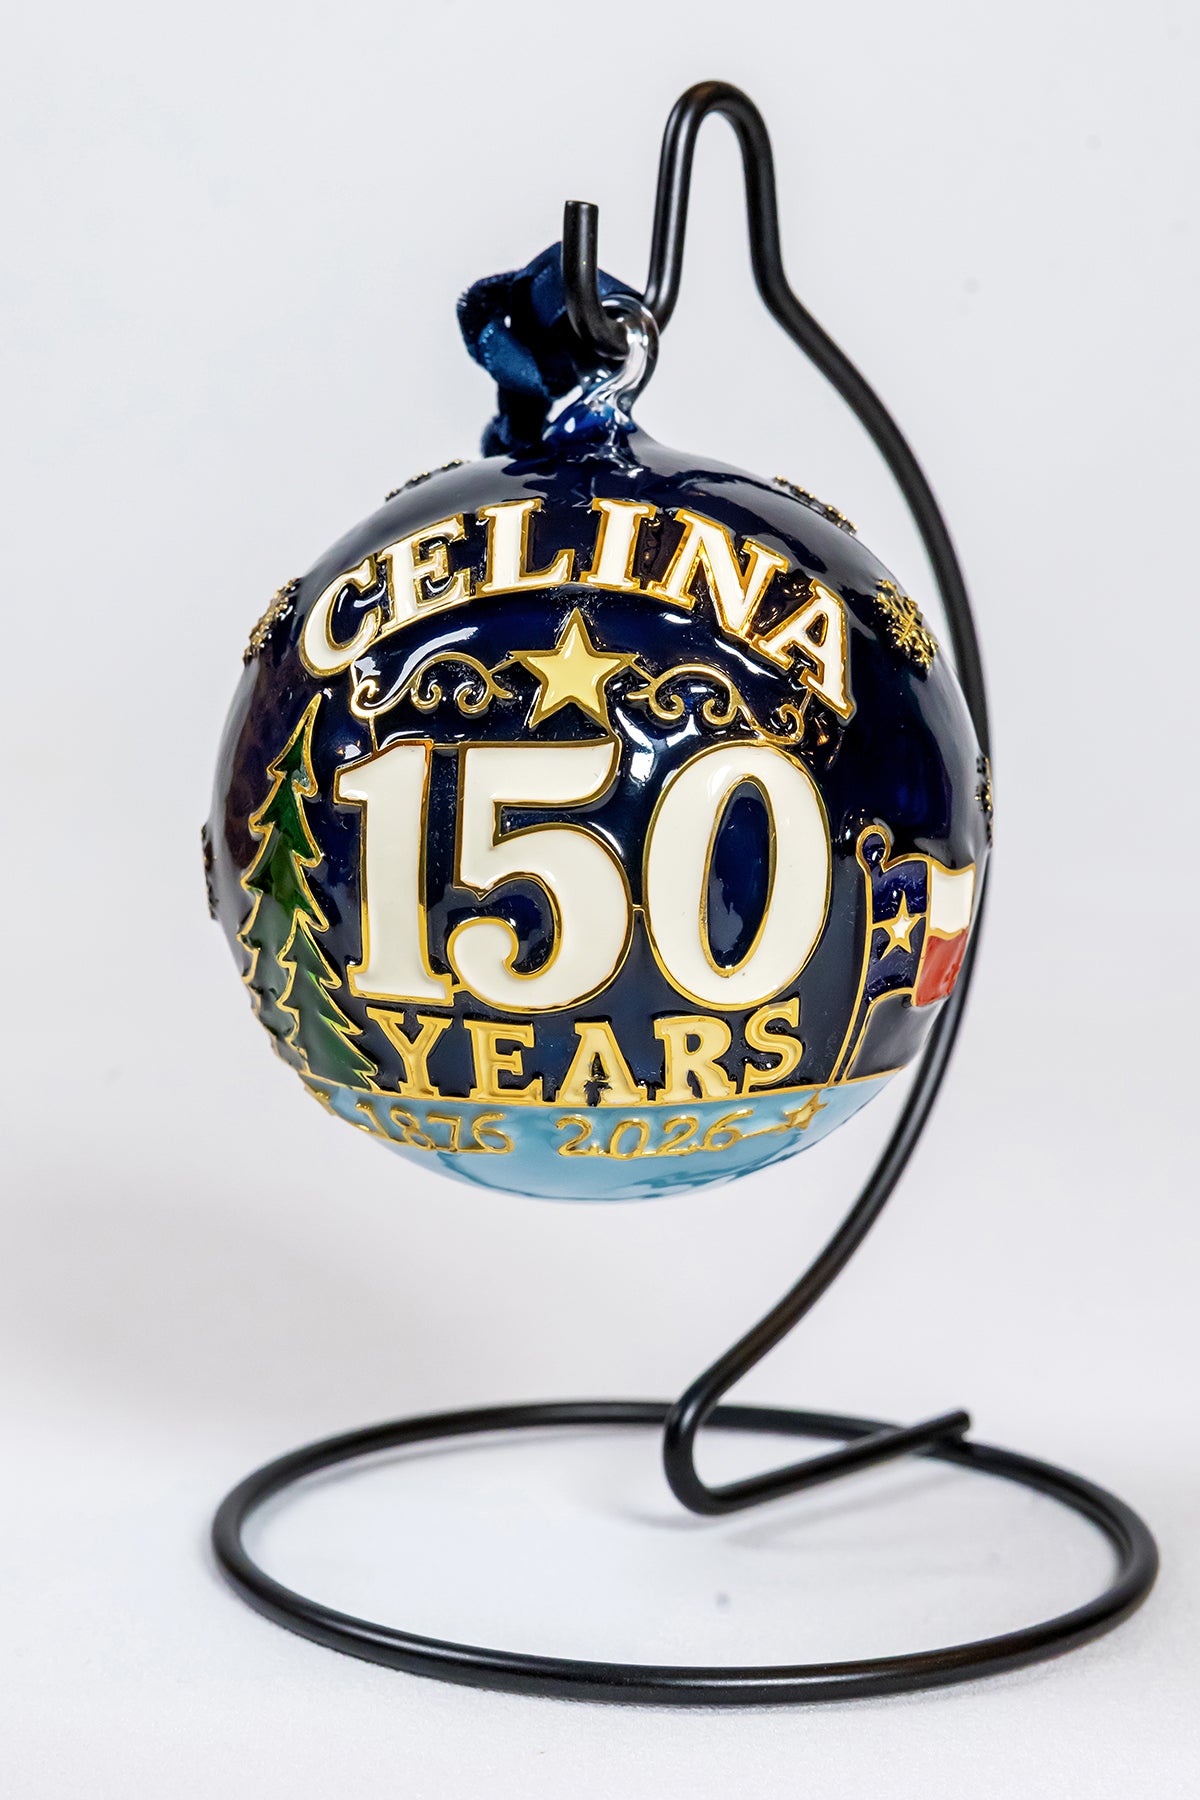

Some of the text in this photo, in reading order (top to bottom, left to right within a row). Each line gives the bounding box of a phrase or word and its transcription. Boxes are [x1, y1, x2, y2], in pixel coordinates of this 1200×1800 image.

[300, 499, 852, 718] CELINA
[334, 740, 830, 1012] 150
[355, 1102, 754, 1160] 1876 2026
[366, 998, 804, 1105] YEARS
